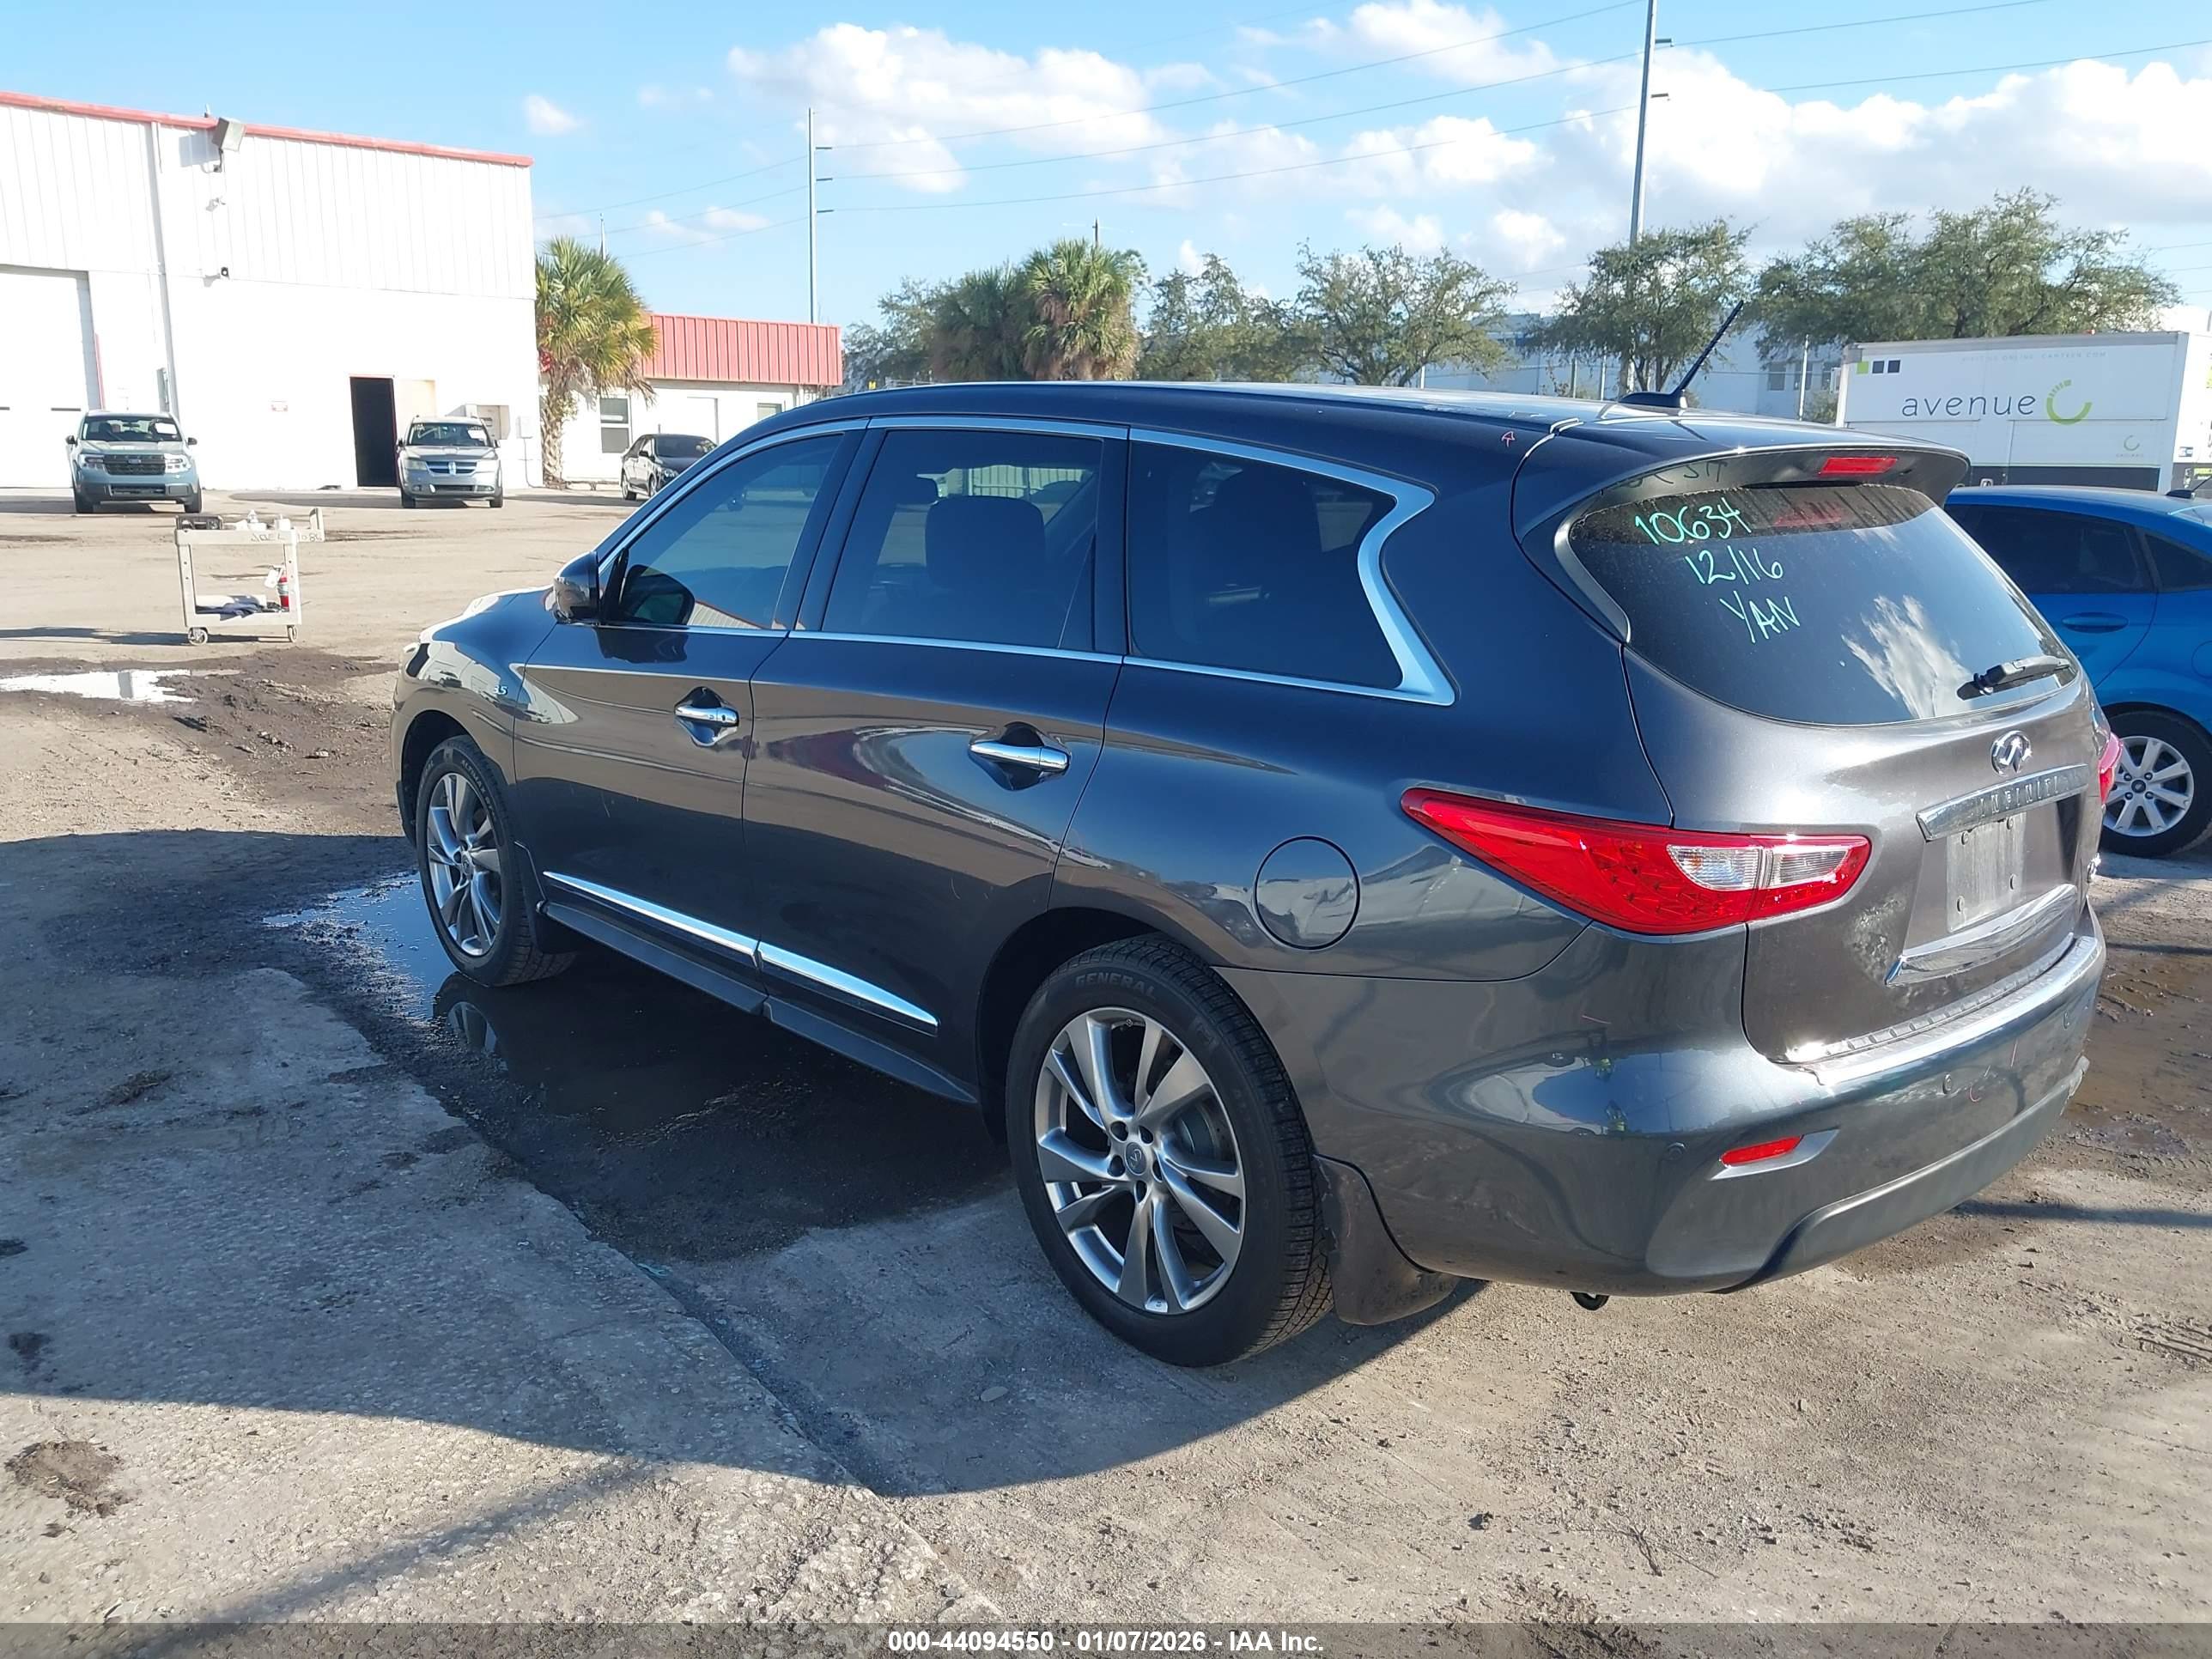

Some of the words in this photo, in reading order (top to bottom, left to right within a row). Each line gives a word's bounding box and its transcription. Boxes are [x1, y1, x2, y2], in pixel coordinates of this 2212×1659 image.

[1901, 395, 2037, 416] avenue
[1634, 496, 1753, 546] 10634
[1684, 544, 1784, 585] 12/16
[1719, 590, 1802, 644] YAN
[1074, 972, 1157, 1001] GENERAL
